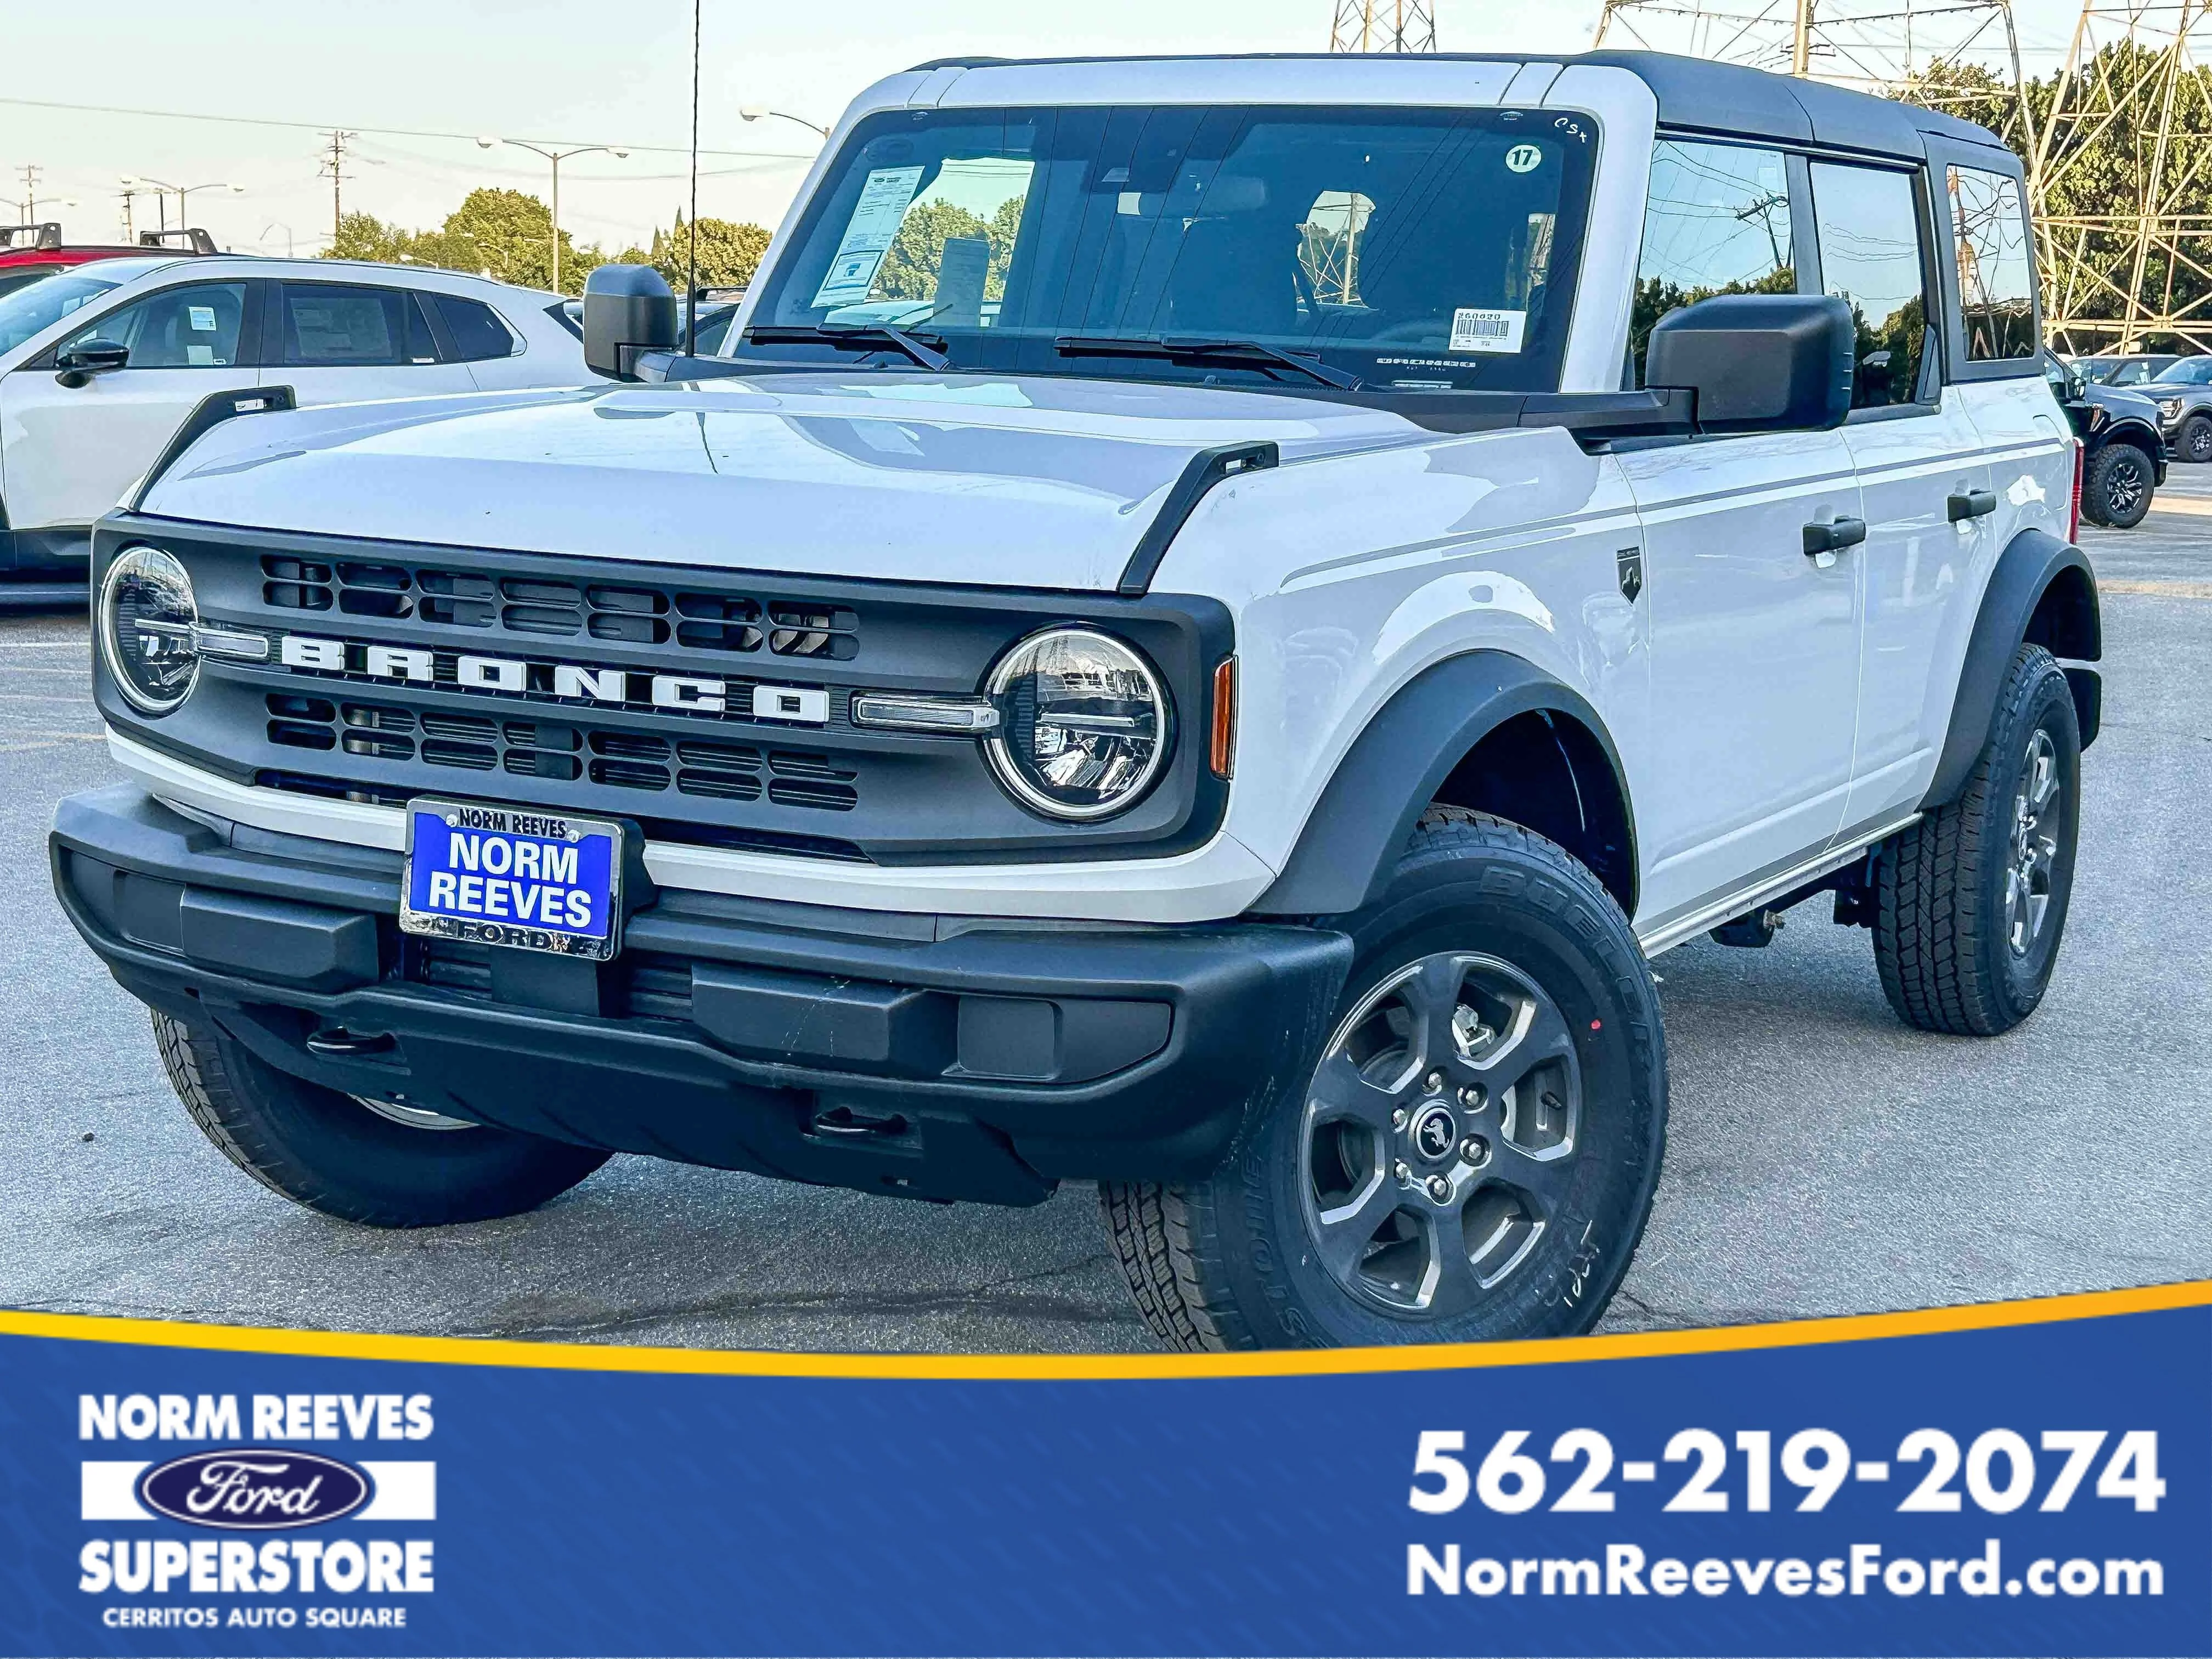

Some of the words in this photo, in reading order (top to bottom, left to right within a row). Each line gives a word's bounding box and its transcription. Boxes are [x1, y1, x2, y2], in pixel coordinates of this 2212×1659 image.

[1511, 149, 1533, 166] 17
[281, 635, 831, 723] BRONCO
[459, 808, 507, 832] NORM
[512, 815, 567, 839] REEVES
[448, 832, 579, 885] NORM
[428, 871, 592, 928] REEVES
[463, 923, 554, 952] FORD
